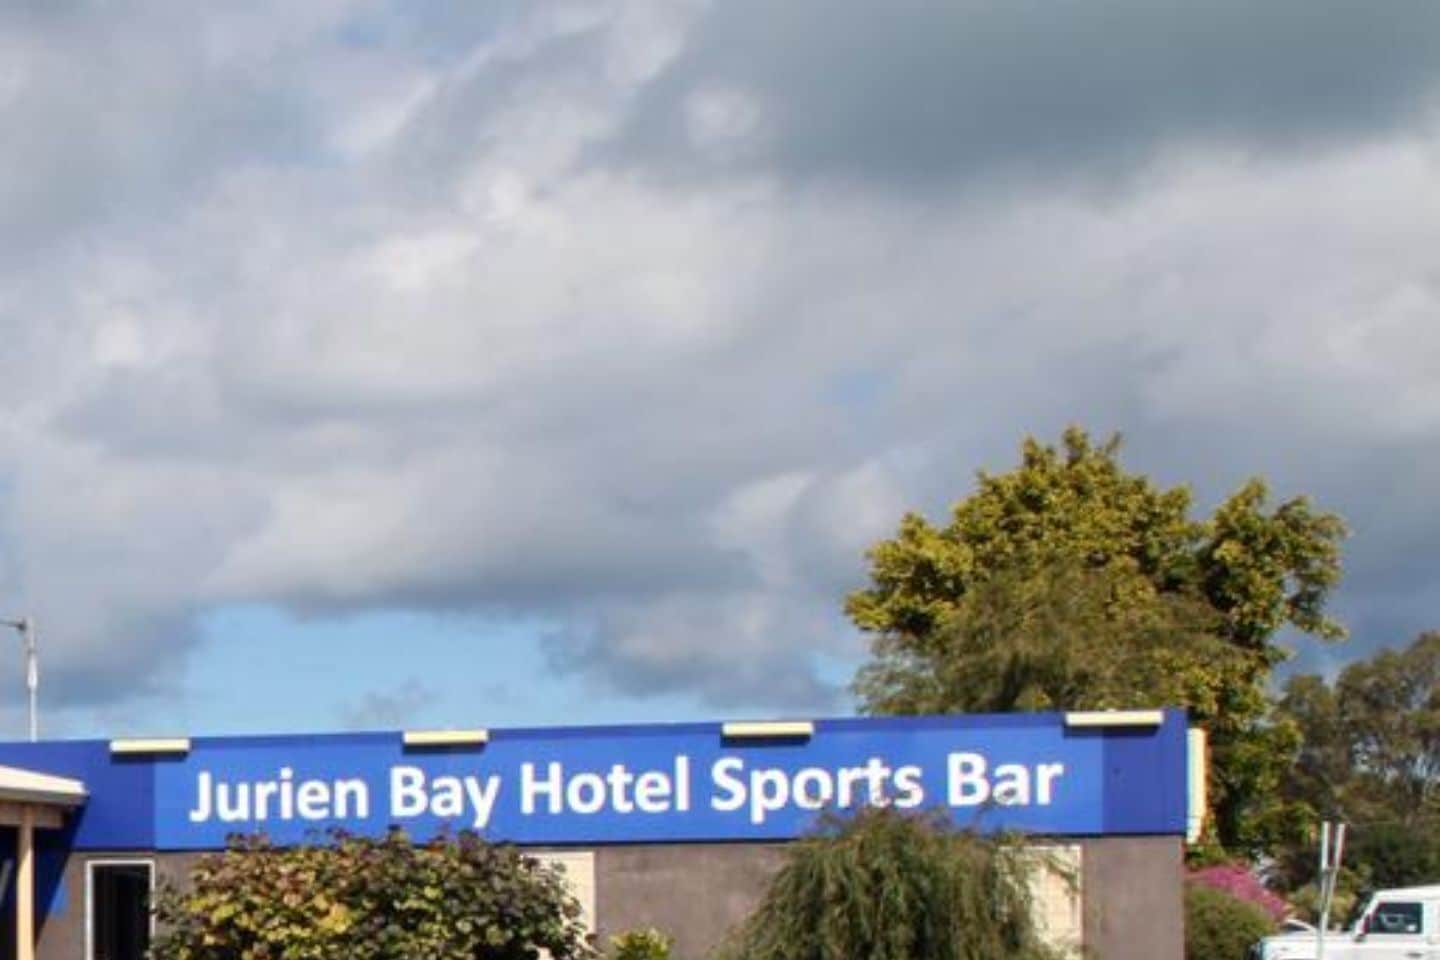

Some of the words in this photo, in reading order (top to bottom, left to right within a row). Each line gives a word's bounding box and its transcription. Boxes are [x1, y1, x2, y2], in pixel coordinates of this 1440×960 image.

[190, 768, 368, 821] Jurien
[391, 766, 500, 828] Bay
[522, 756, 689, 813] Hotel
[710, 756, 925, 824] Sports
[947, 752, 1064, 806] Bar
